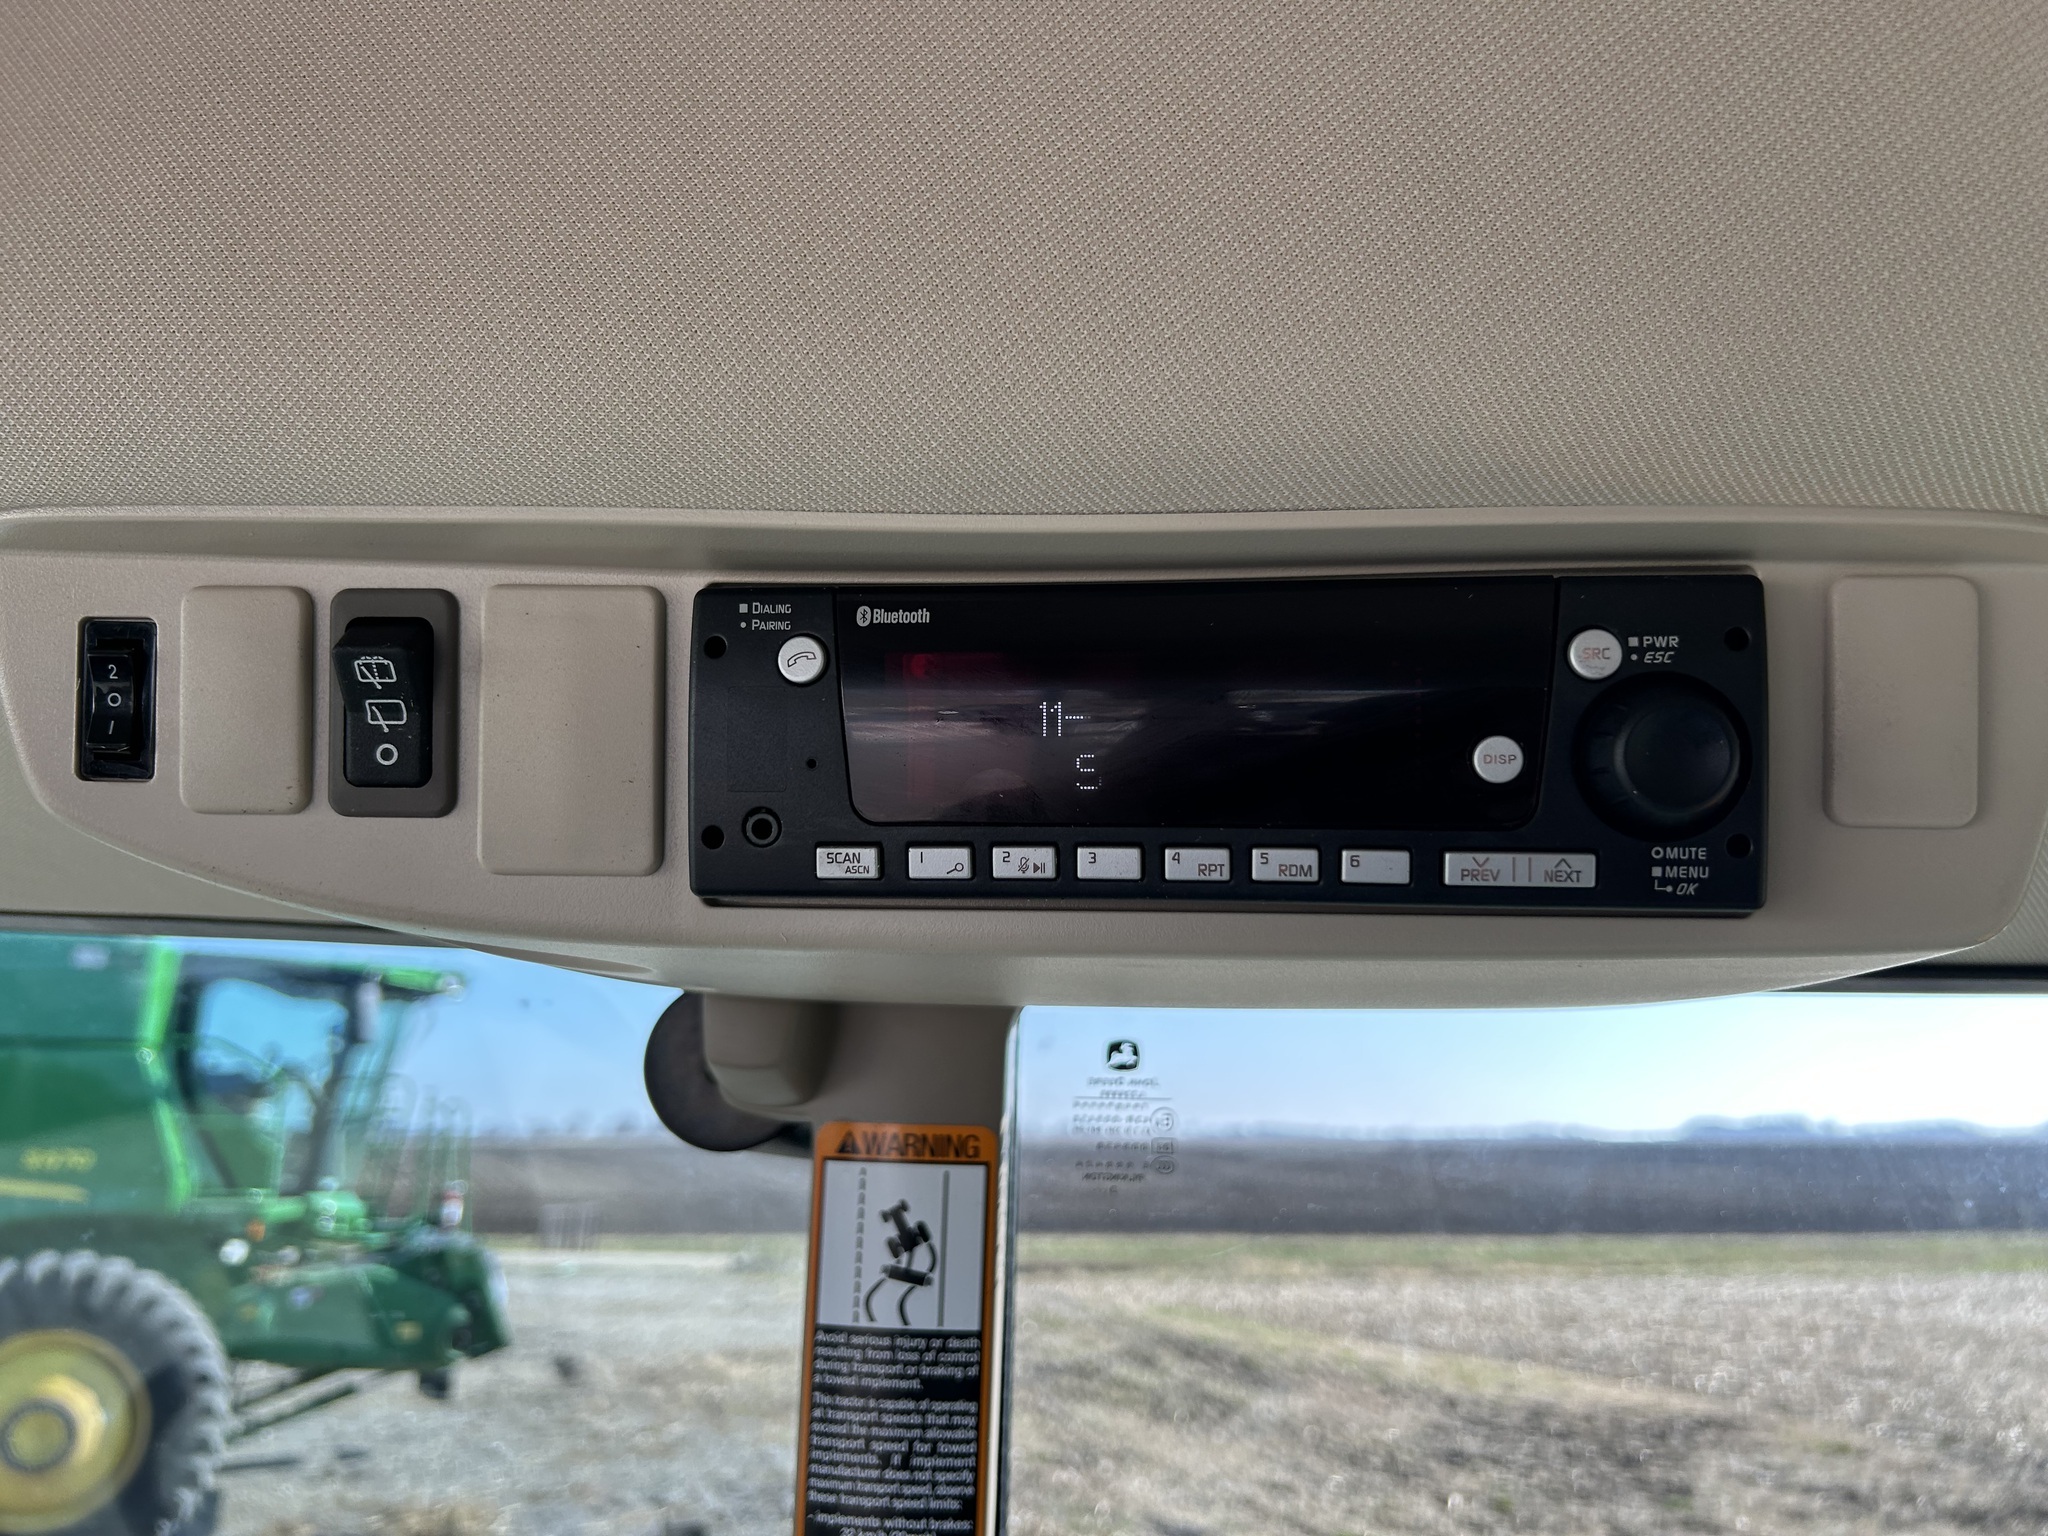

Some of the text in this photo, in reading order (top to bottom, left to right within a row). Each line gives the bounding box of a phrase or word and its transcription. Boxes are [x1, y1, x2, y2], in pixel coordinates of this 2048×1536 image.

[873, 608, 930, 624] Bluetooth
[1642, 636, 1679, 648] PWR
[1582, 647, 1611, 660] SRC
[1643, 652, 1675, 663] ESC
[108, 664, 119, 679] 2
[1483, 754, 1517, 765] DISP
[826, 852, 861, 864] SCAN
[1002, 851, 1011, 863] 2
[1088, 852, 1097, 864] 3
[1171, 852, 1181, 865] 4
[1260, 853, 1269, 865] 5
[1666, 847, 1707, 860] MUTE
[1350, 855, 1360, 868] 6
[845, 865, 870, 874] ASCN
[1198, 863, 1225, 877] RPT
[1278, 864, 1312, 878] RDM
[1460, 868, 1500, 882] PREV
[1665, 866, 1709, 879] MENU
[1544, 870, 1582, 883] NEXT
[1676, 883, 1699, 895] OK
[863, 1131, 981, 1158] WARNING
[815, 1330, 847, 1343] Avoid
[945, 1336, 980, 1348] death
